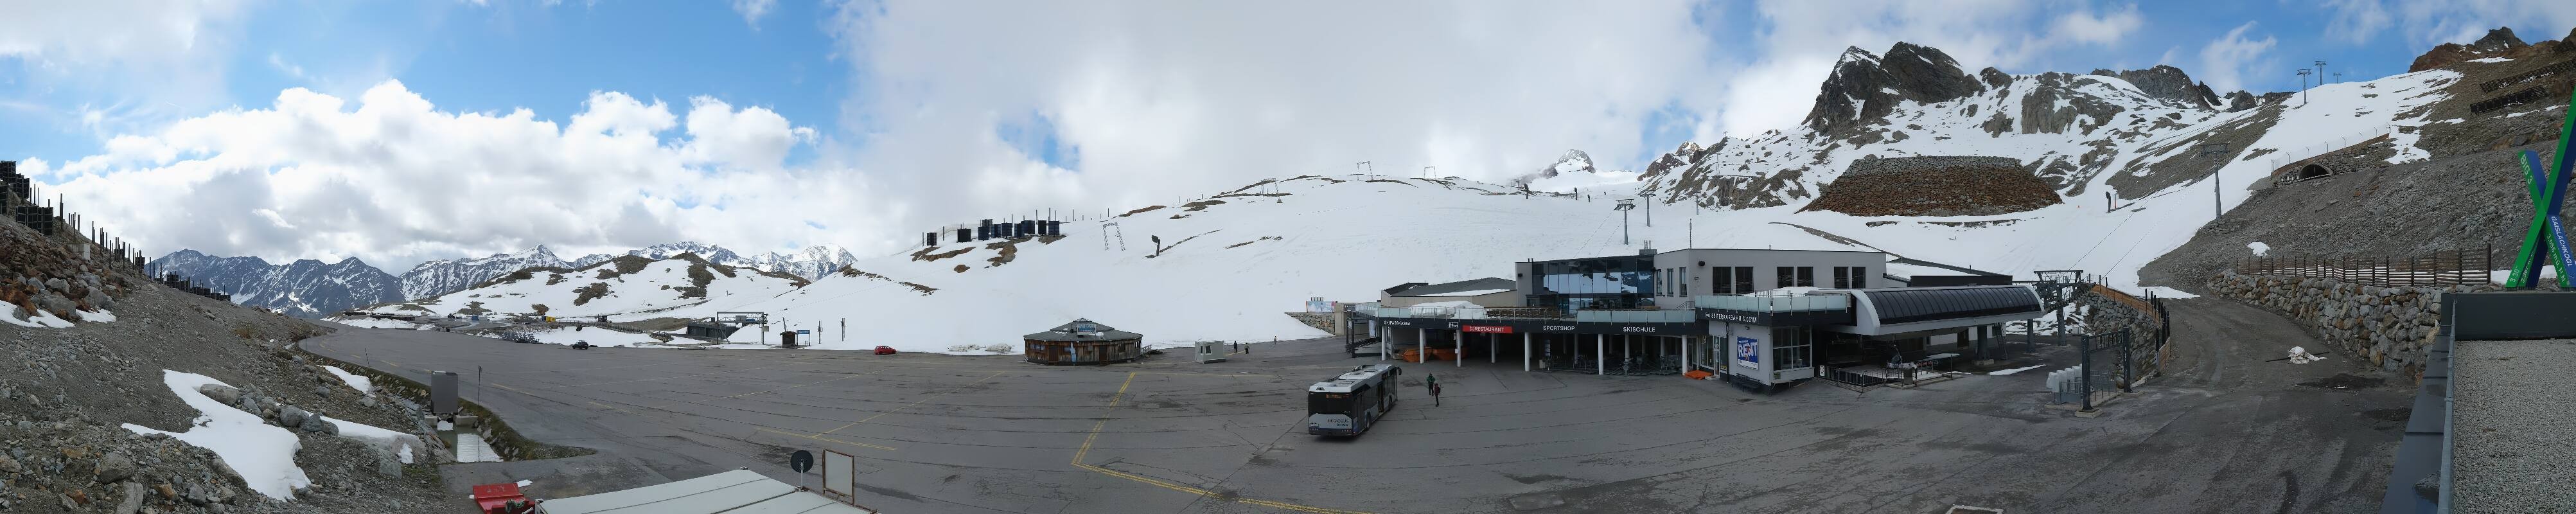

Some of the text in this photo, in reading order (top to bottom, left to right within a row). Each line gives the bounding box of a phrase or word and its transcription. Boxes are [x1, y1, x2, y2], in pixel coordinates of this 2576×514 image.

[2521, 154, 2533, 184] BIG 3
[2551, 216, 2573, 268] GAISLACHKOGL
[1738, 342, 1758, 357] RENT
